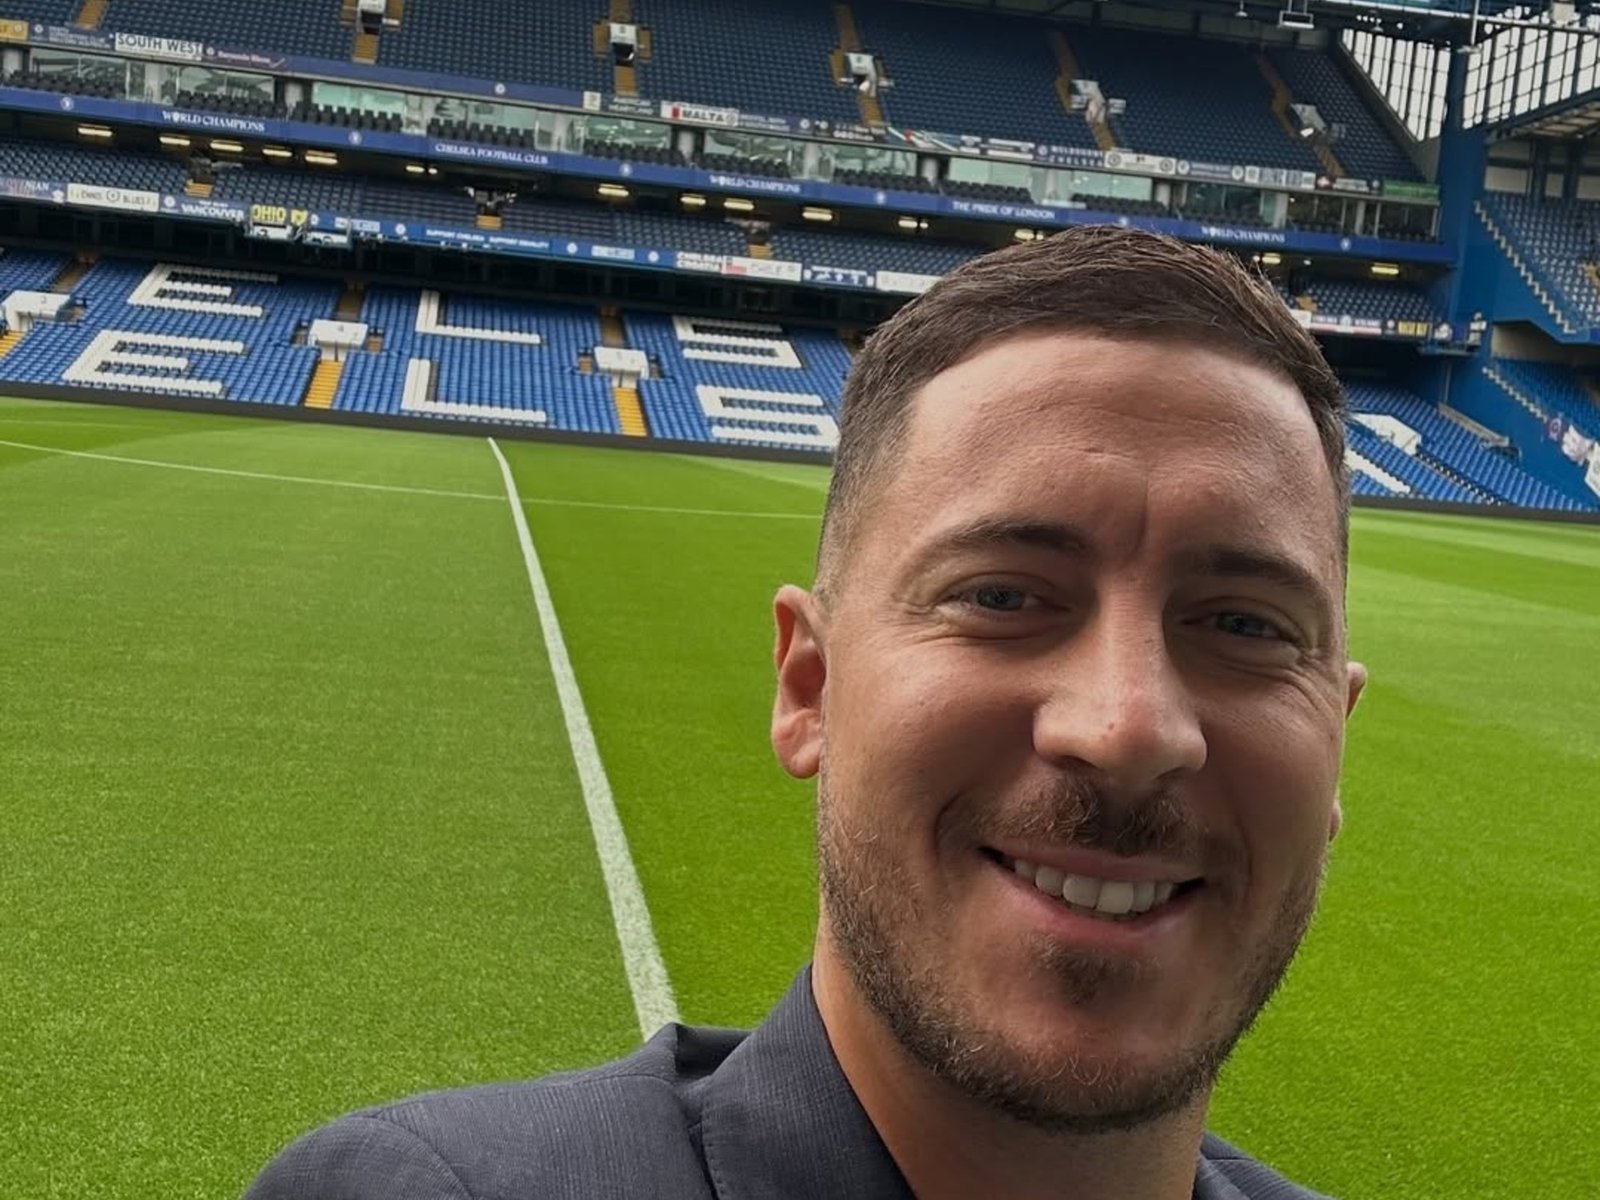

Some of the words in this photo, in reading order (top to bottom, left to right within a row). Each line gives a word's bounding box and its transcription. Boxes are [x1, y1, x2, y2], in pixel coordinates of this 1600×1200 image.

[118, 33, 162, 50] SOUTH
[166, 40, 201, 55] WEST
[162, 110, 201, 125] WORLD
[203, 115, 265, 132] CHAMPIONS
[682, 109, 724, 122] MALTA
[435, 143, 476, 155] CHELSEA
[477, 148, 523, 162] FOOTBALL
[524, 154, 548, 165] CLUB
[709, 174, 744, 187] WORLD
[745, 180, 801, 193] CHAMPIONS
[181, 203, 244, 222] VANCOUVER
[251, 204, 286, 222] OHIO
[952, 200, 970, 211] THE
[972, 203, 998, 214] PRIDE
[1000, 205, 1014, 216] OF
[1015, 207, 1055, 219] LONDON
[1201, 226, 1234, 238] WORLD
[1234, 229, 1285, 243] CHAMPIONS
